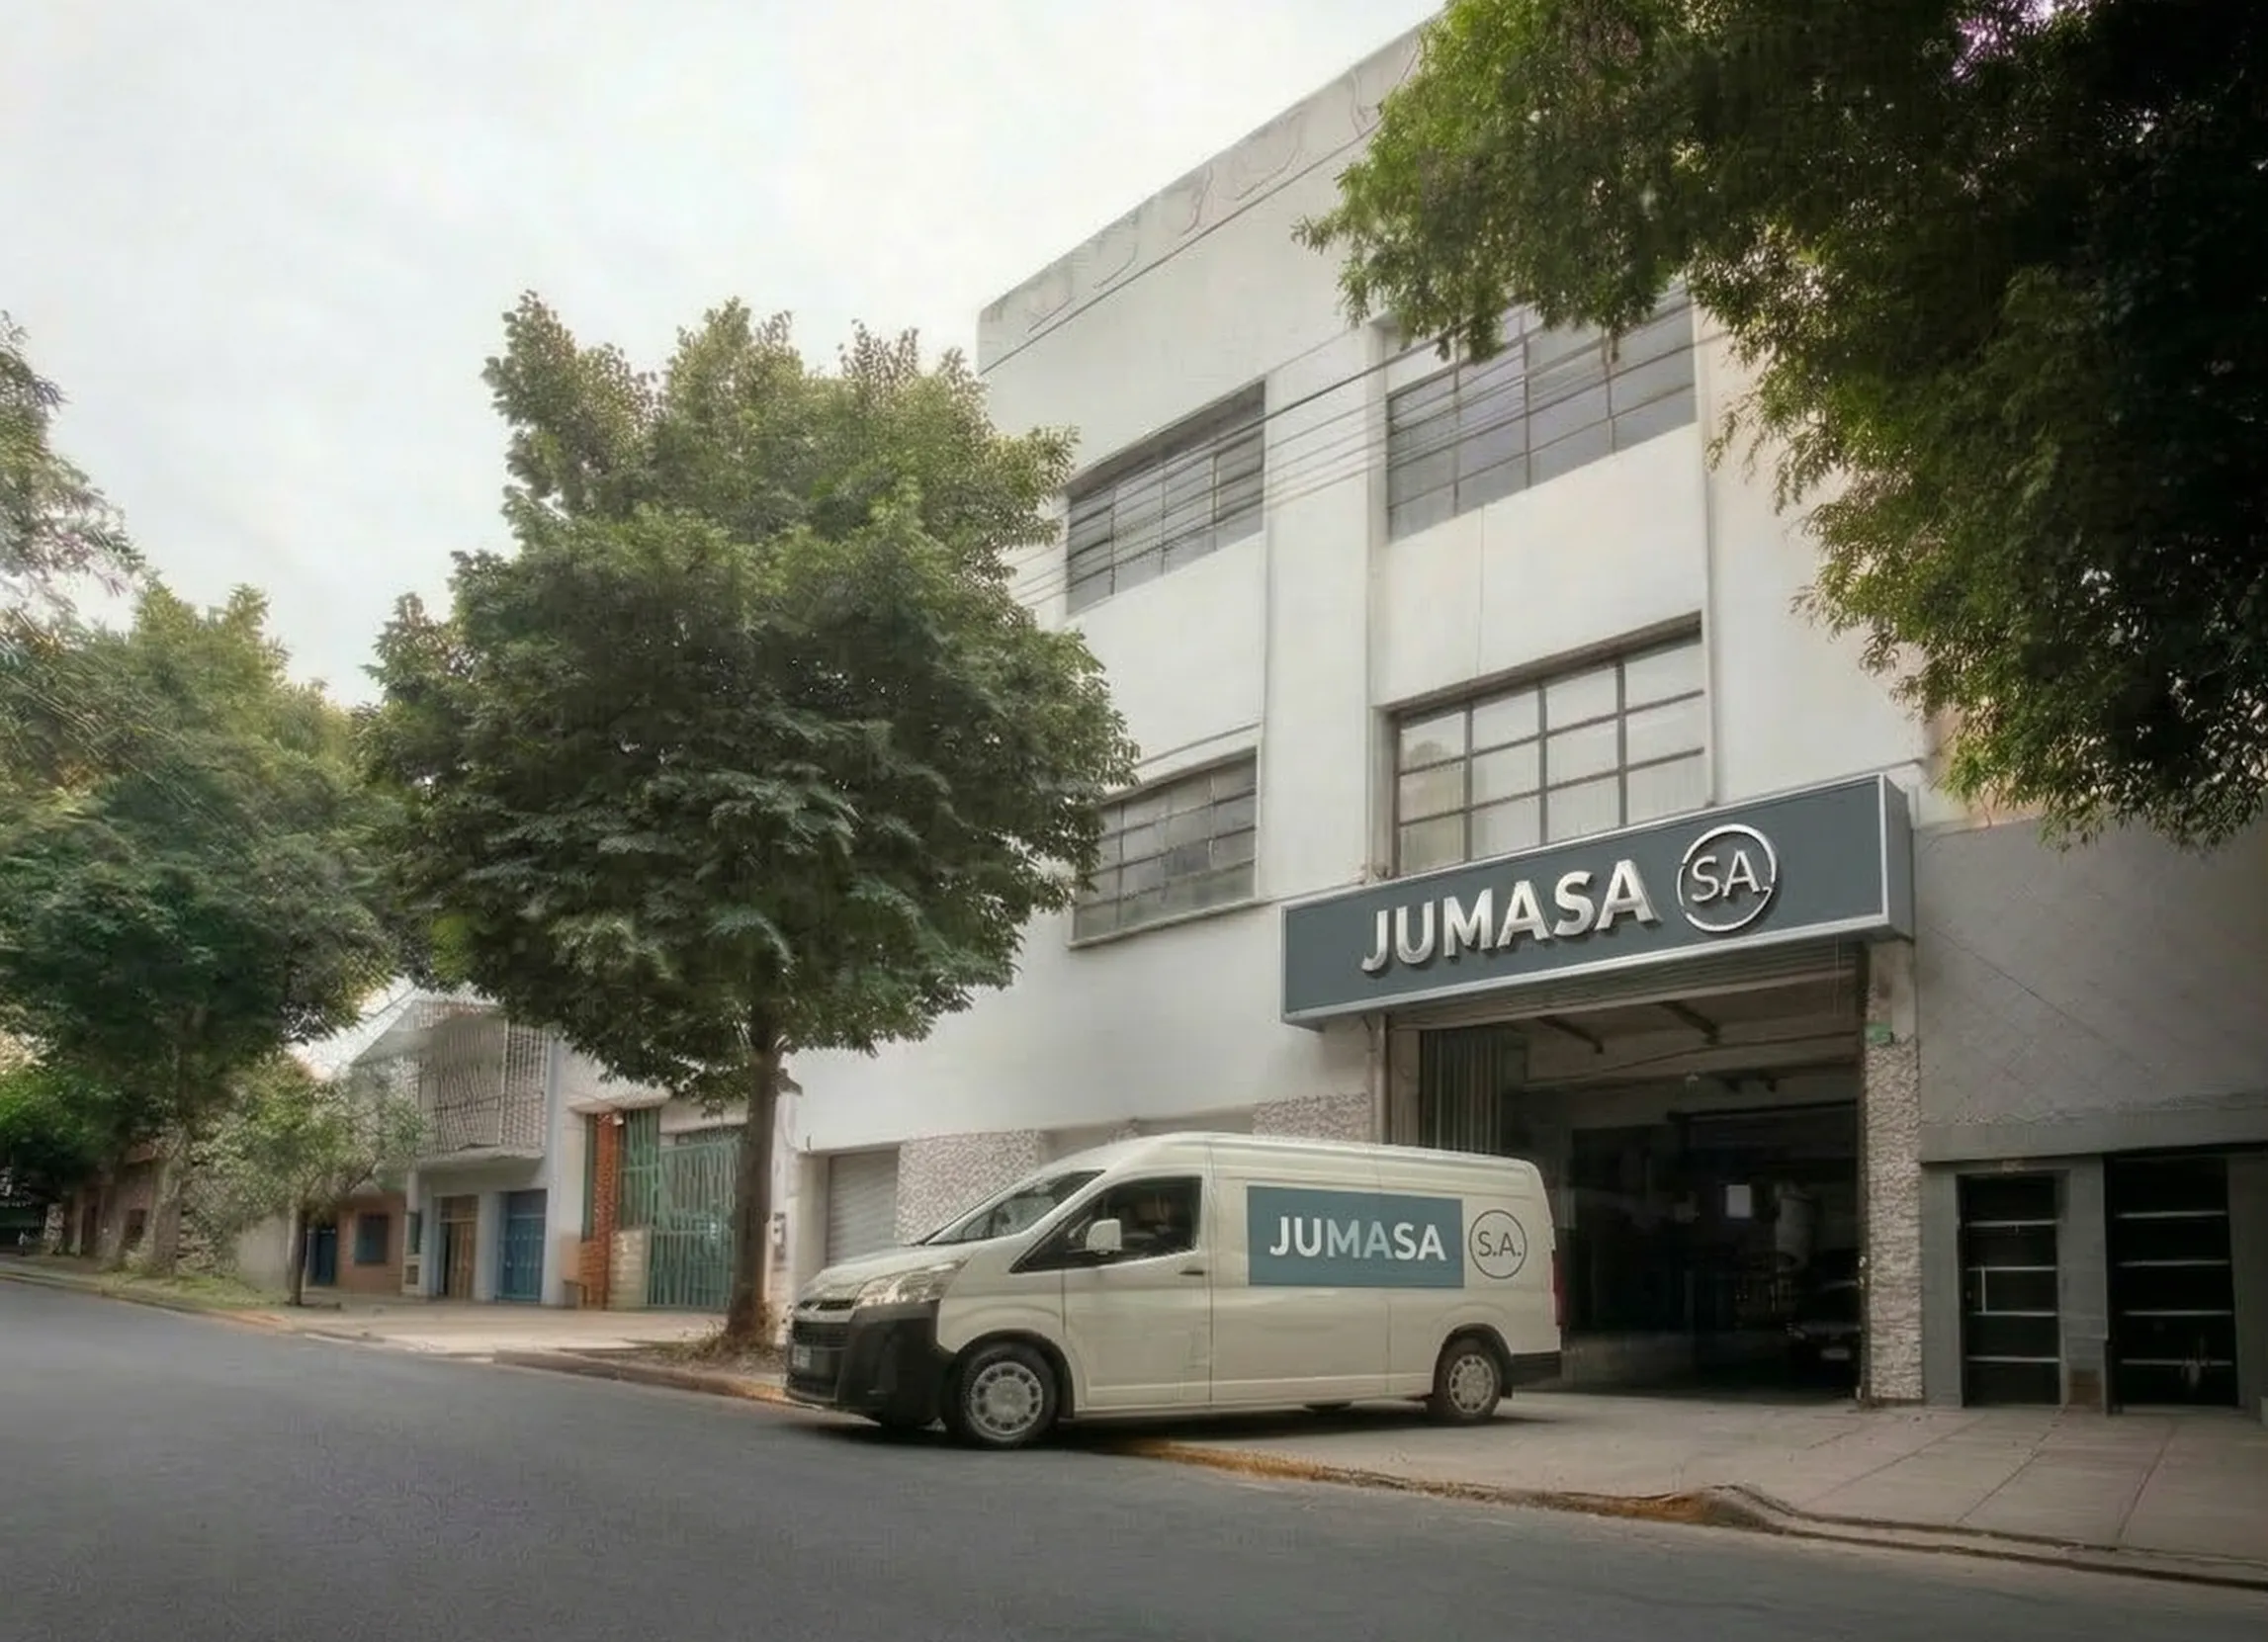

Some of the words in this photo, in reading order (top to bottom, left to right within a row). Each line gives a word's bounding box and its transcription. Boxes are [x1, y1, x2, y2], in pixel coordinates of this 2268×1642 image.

[1361, 858, 1658, 973] JUMASA
[1269, 1216, 1447, 1261] JUMASA
[1477, 1230, 1523, 1257] S.A.
